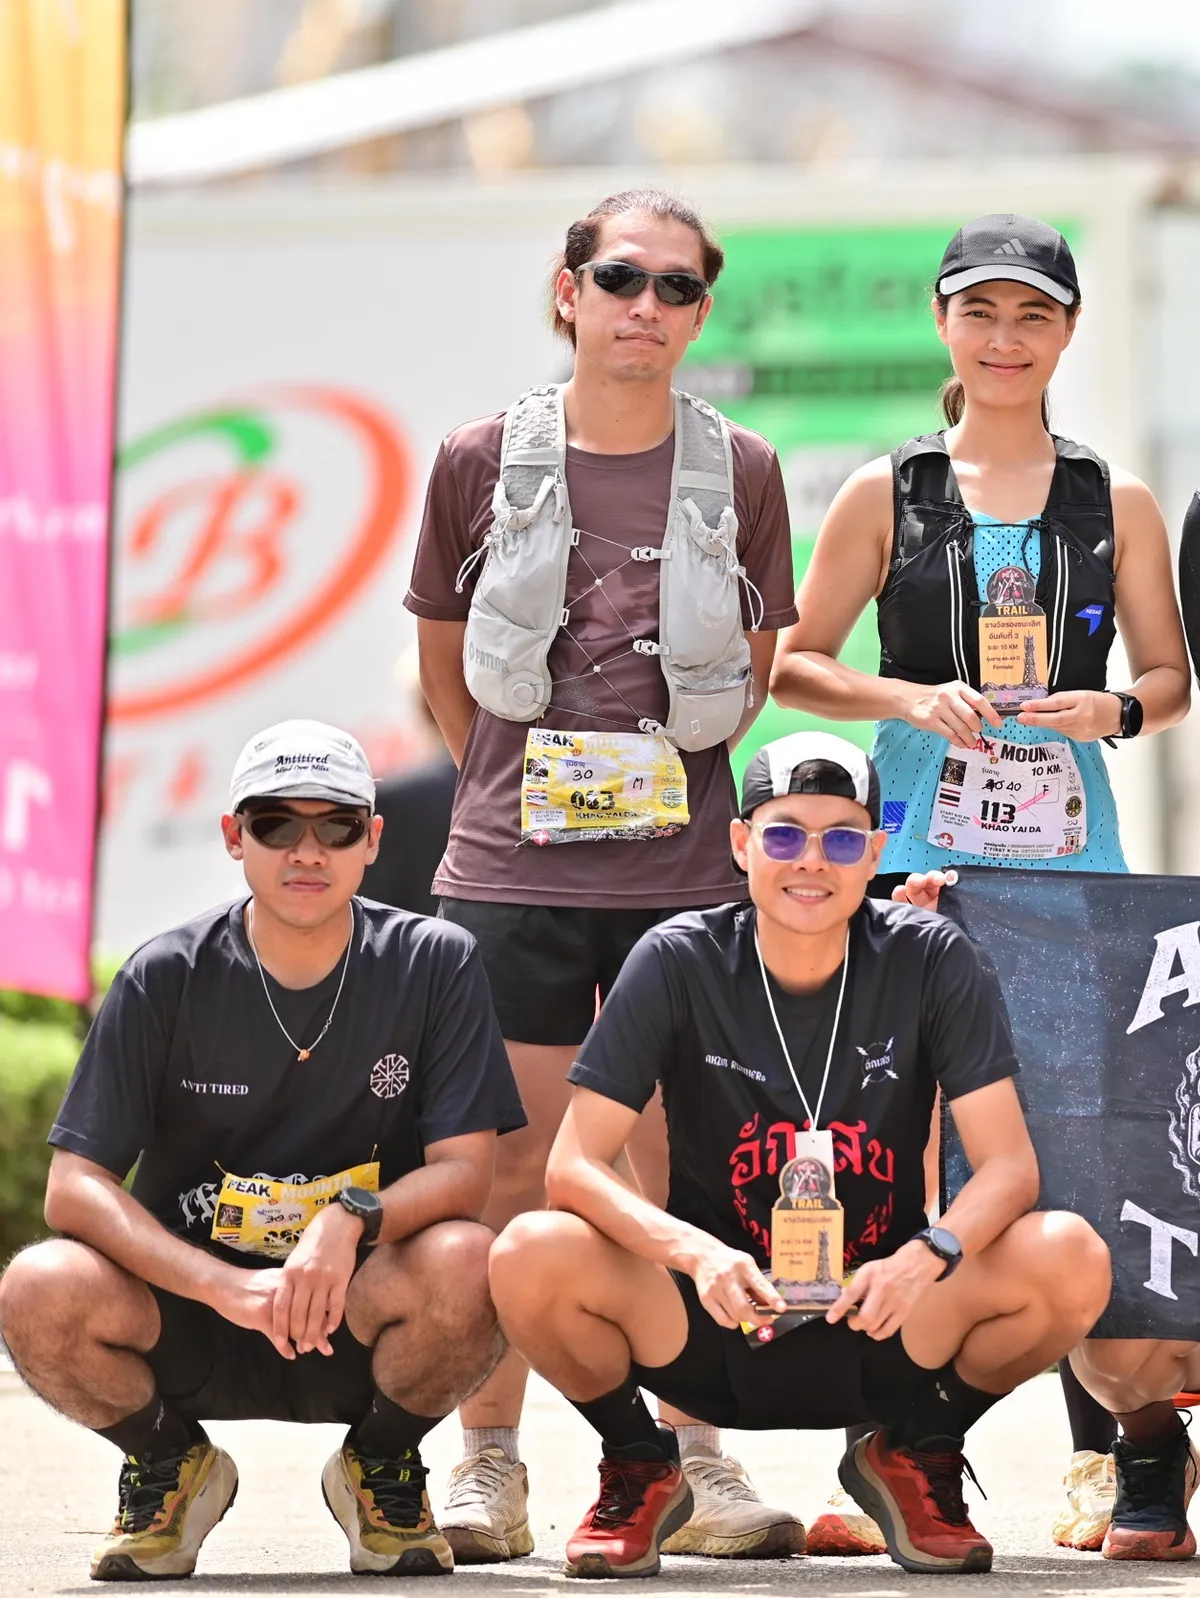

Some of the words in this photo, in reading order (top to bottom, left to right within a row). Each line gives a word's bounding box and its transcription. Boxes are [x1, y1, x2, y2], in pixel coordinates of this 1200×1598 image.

[996, 605, 1028, 615] TRAIL
[274, 753, 330, 767] Antitired
[573, 769, 593, 781] 30
[1031, 766, 1044, 776] 10
[1046, 763, 1063, 775] KM.
[632, 777, 644, 790] M
[1042, 784, 1050, 796] F
[981, 799, 1016, 825] 113
[981, 822, 1009, 833] KHAO
[1012, 825, 1028, 833] YAI
[1029, 825, 1042, 833] DA
[180, 1079, 207, 1094] ANTI
[209, 1083, 249, 1095] TIRED
[791, 1198, 825, 1209] TRAIL
